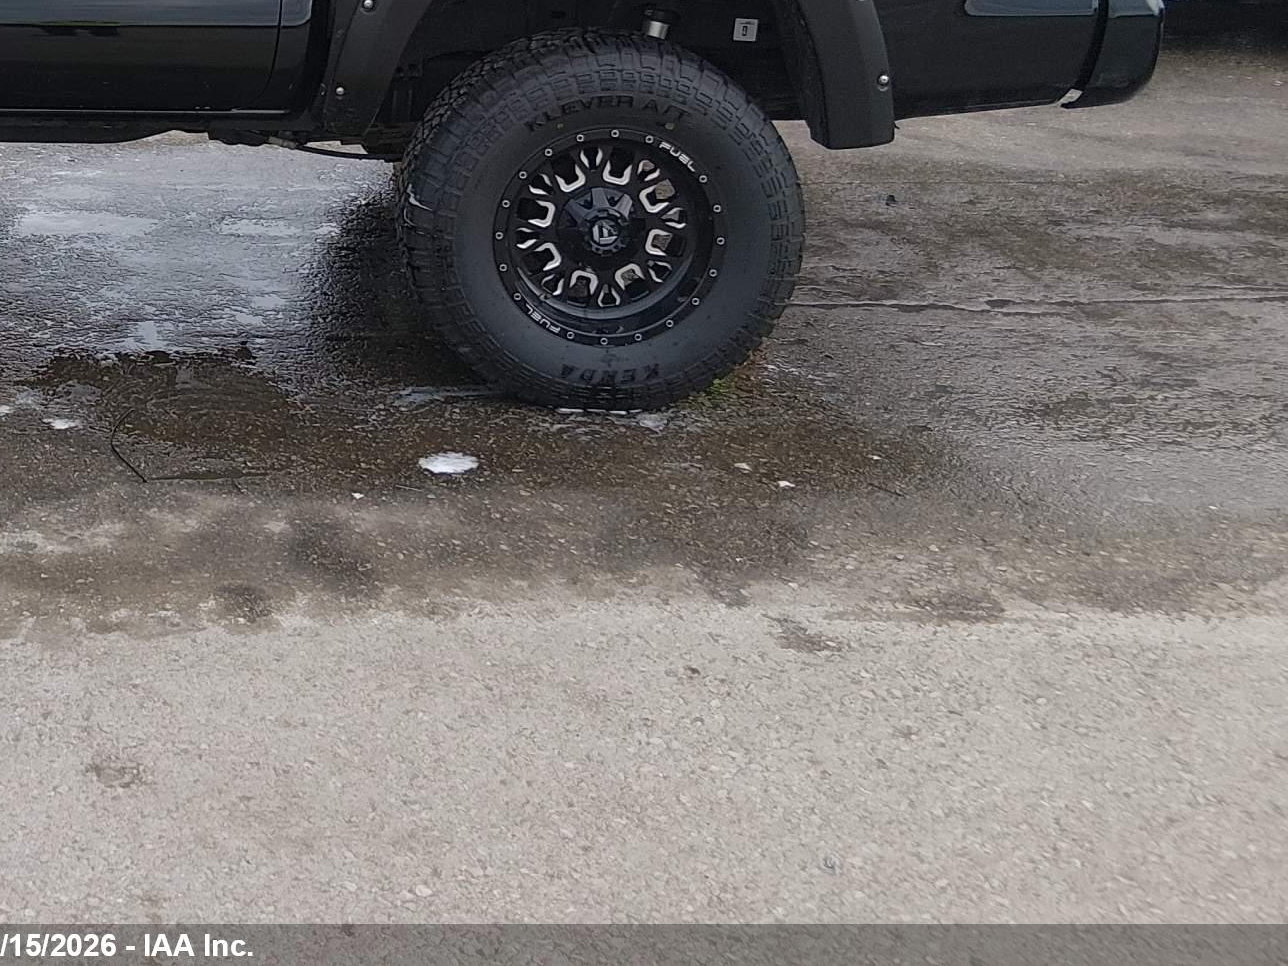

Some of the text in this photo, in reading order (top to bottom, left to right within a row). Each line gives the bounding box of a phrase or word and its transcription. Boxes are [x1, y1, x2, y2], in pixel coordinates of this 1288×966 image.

[658, 141, 696, 173] FUEL
[525, 302, 561, 334] FUEL
[560, 362, 661, 384] KENDA
